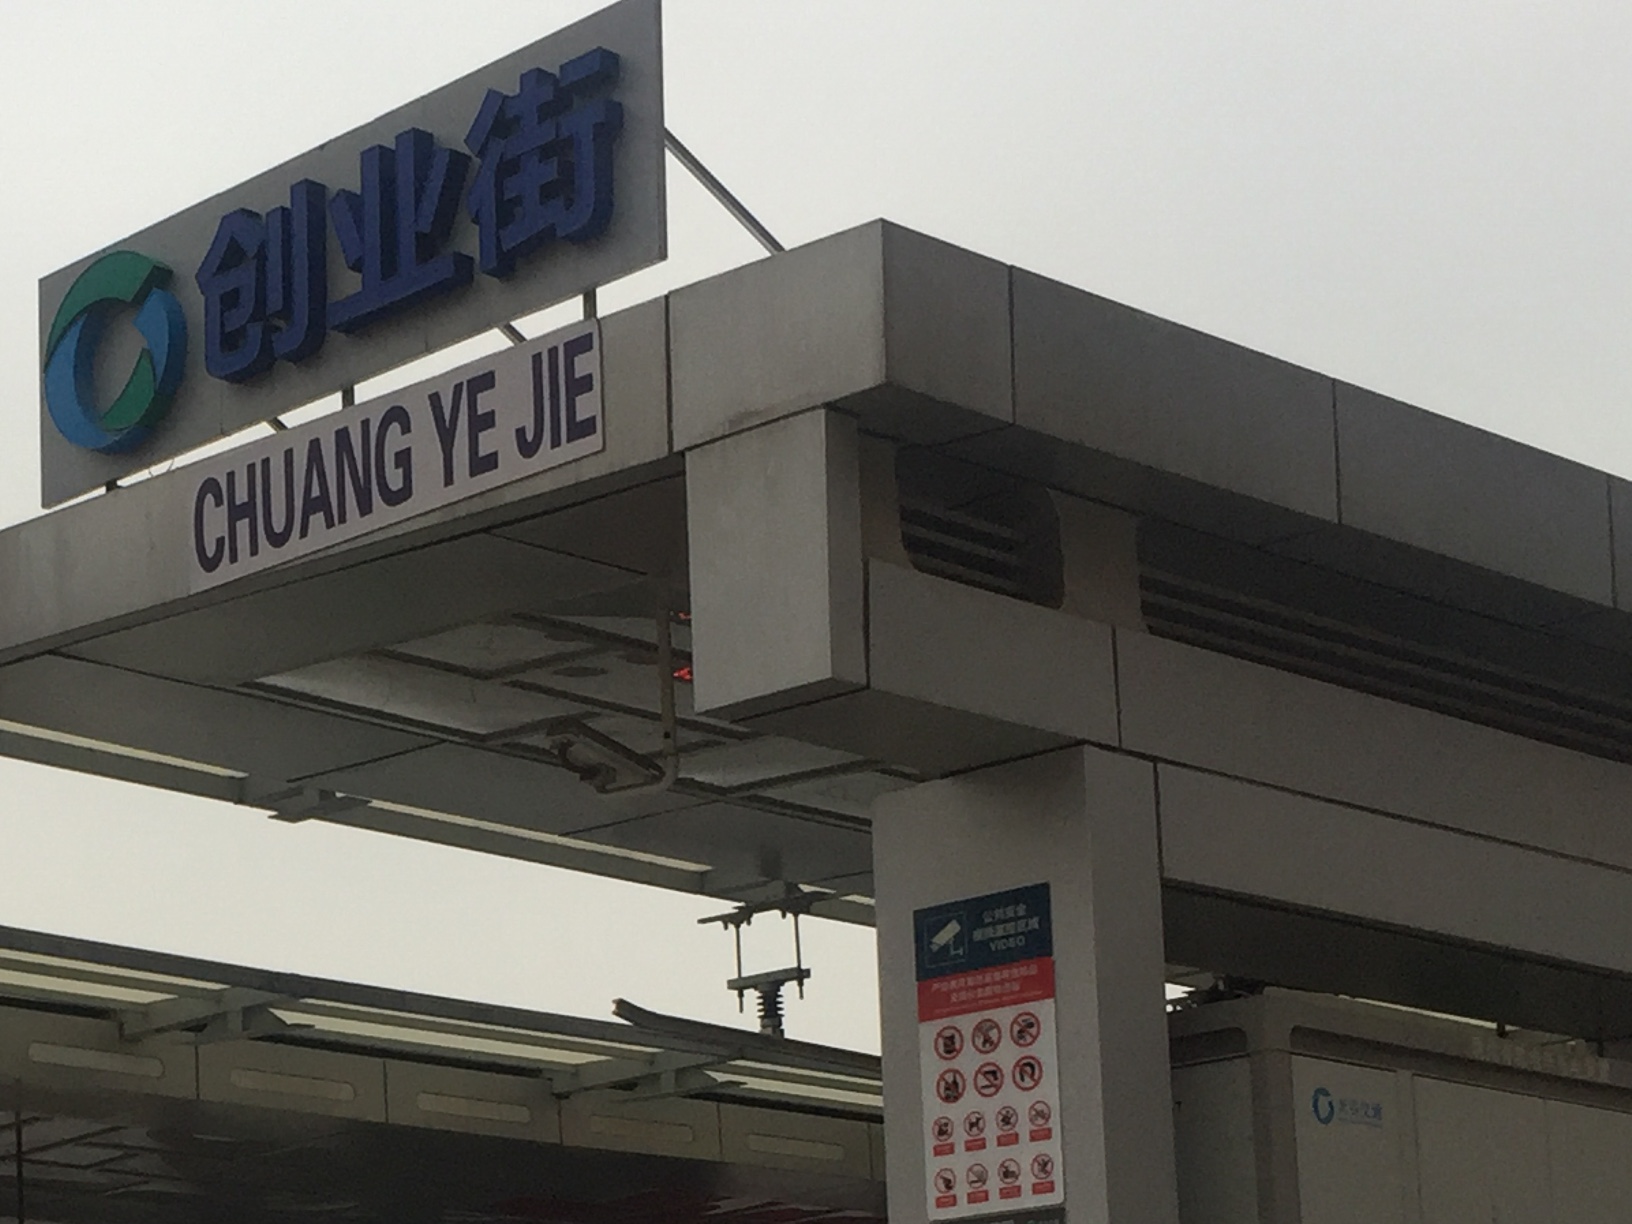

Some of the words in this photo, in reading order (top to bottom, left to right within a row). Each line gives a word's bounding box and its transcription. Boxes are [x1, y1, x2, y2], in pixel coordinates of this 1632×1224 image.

[195, 46, 625, 384] 创业街
[194, 404, 414, 574] CHUANG
[427, 369, 499, 488] YE
[515, 332, 598, 460] JIE
[989, 935, 1026, 952] VIDEO
